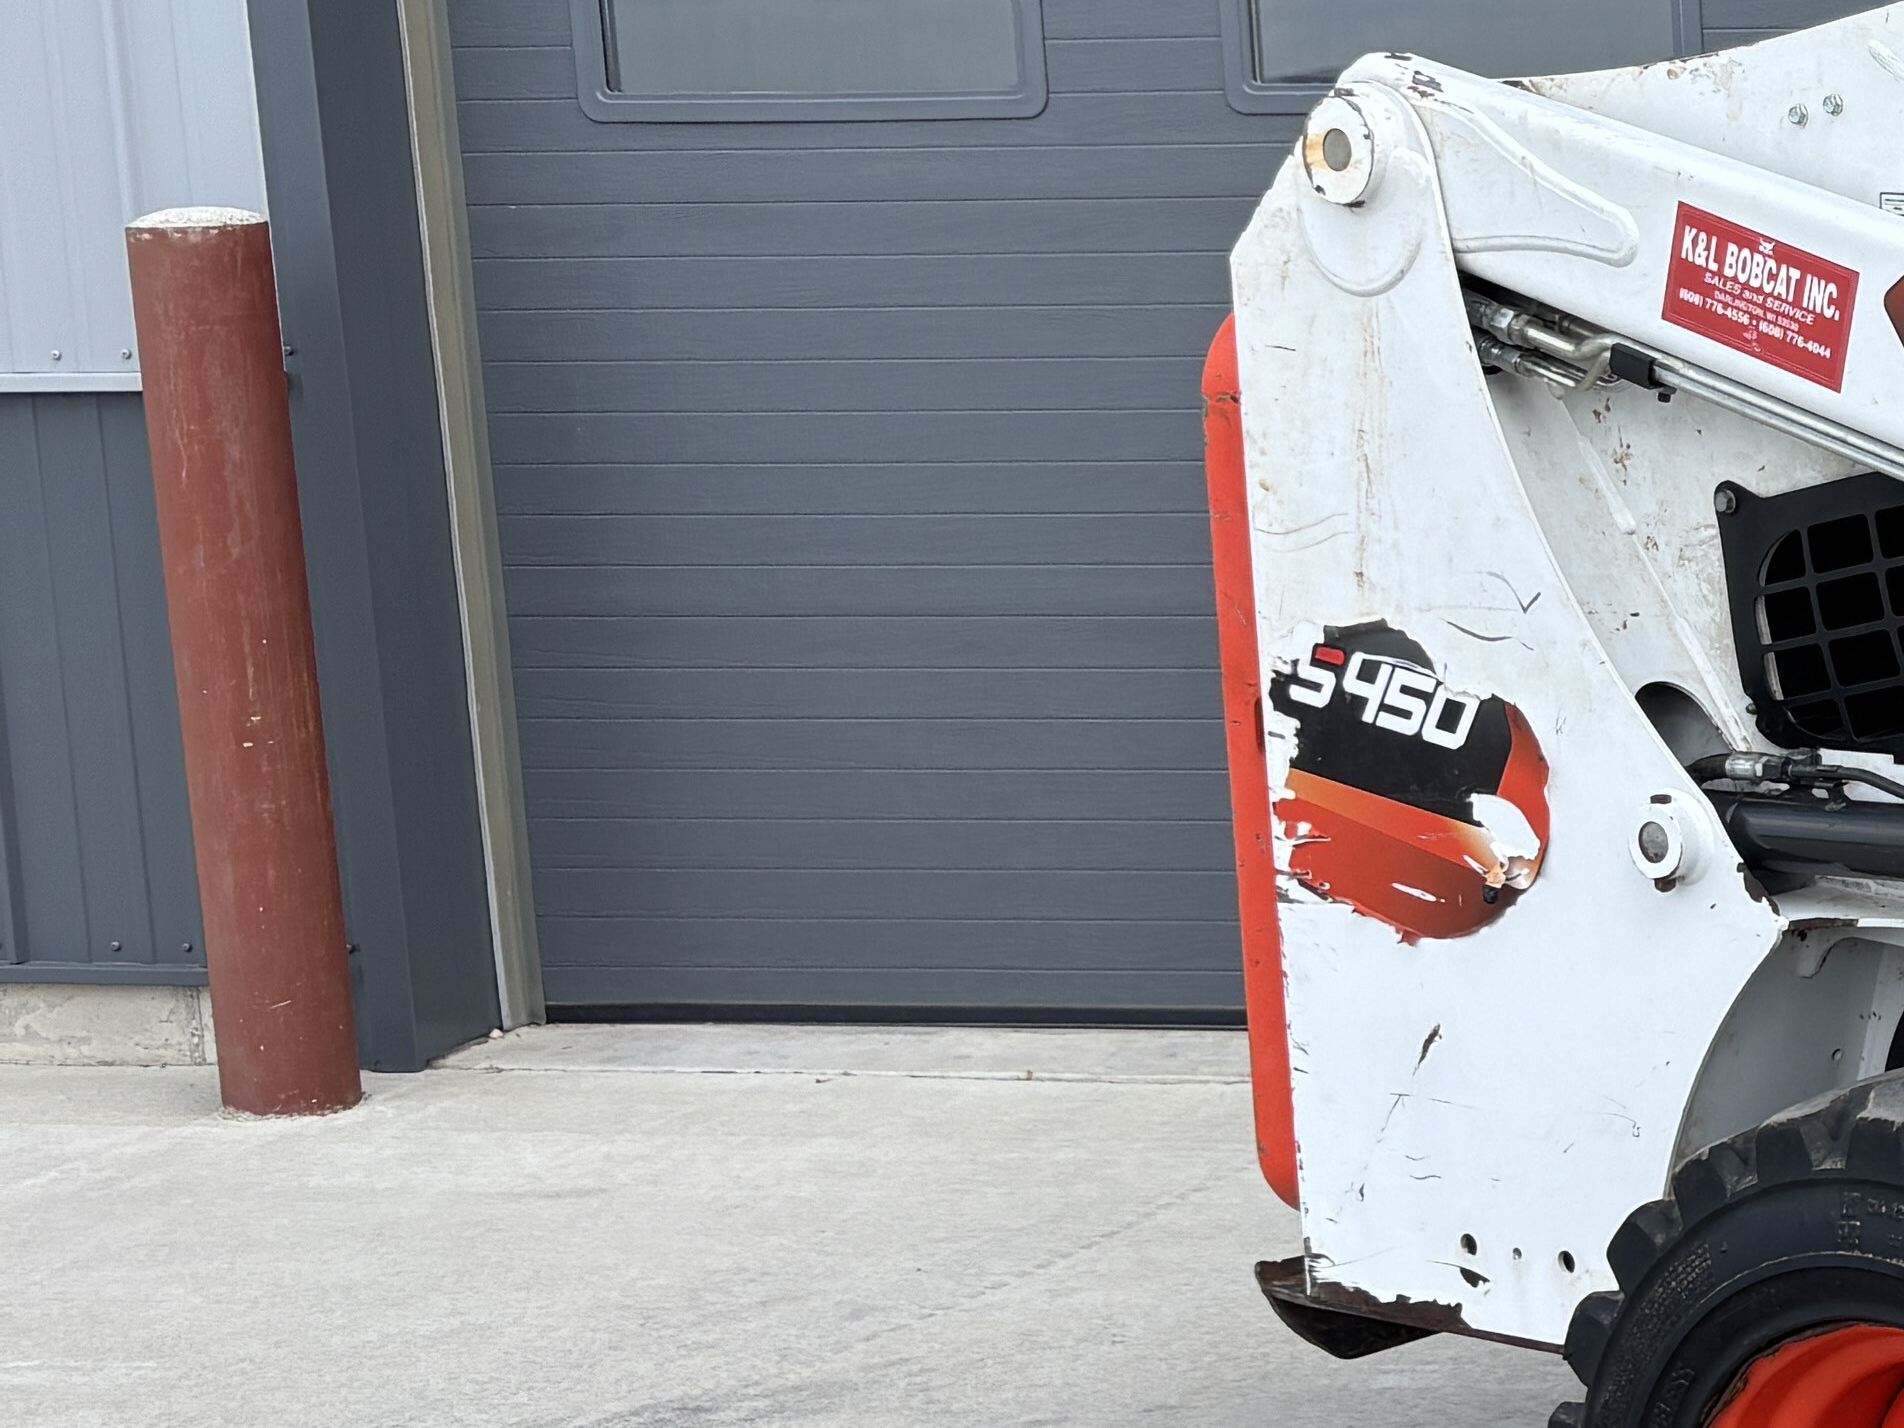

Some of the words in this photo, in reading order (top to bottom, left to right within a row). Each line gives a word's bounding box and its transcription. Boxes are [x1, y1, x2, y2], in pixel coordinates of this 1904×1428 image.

[1681, 225, 1719, 272] K&L
[1723, 242, 1801, 303] BOBCAT
[1802, 274, 1840, 321] INC.
[1704, 273, 1741, 294] SALES
[1742, 289, 1764, 304] and
[1765, 297, 1816, 325] SERVICE
[1289, 645, 1481, 750] S450
